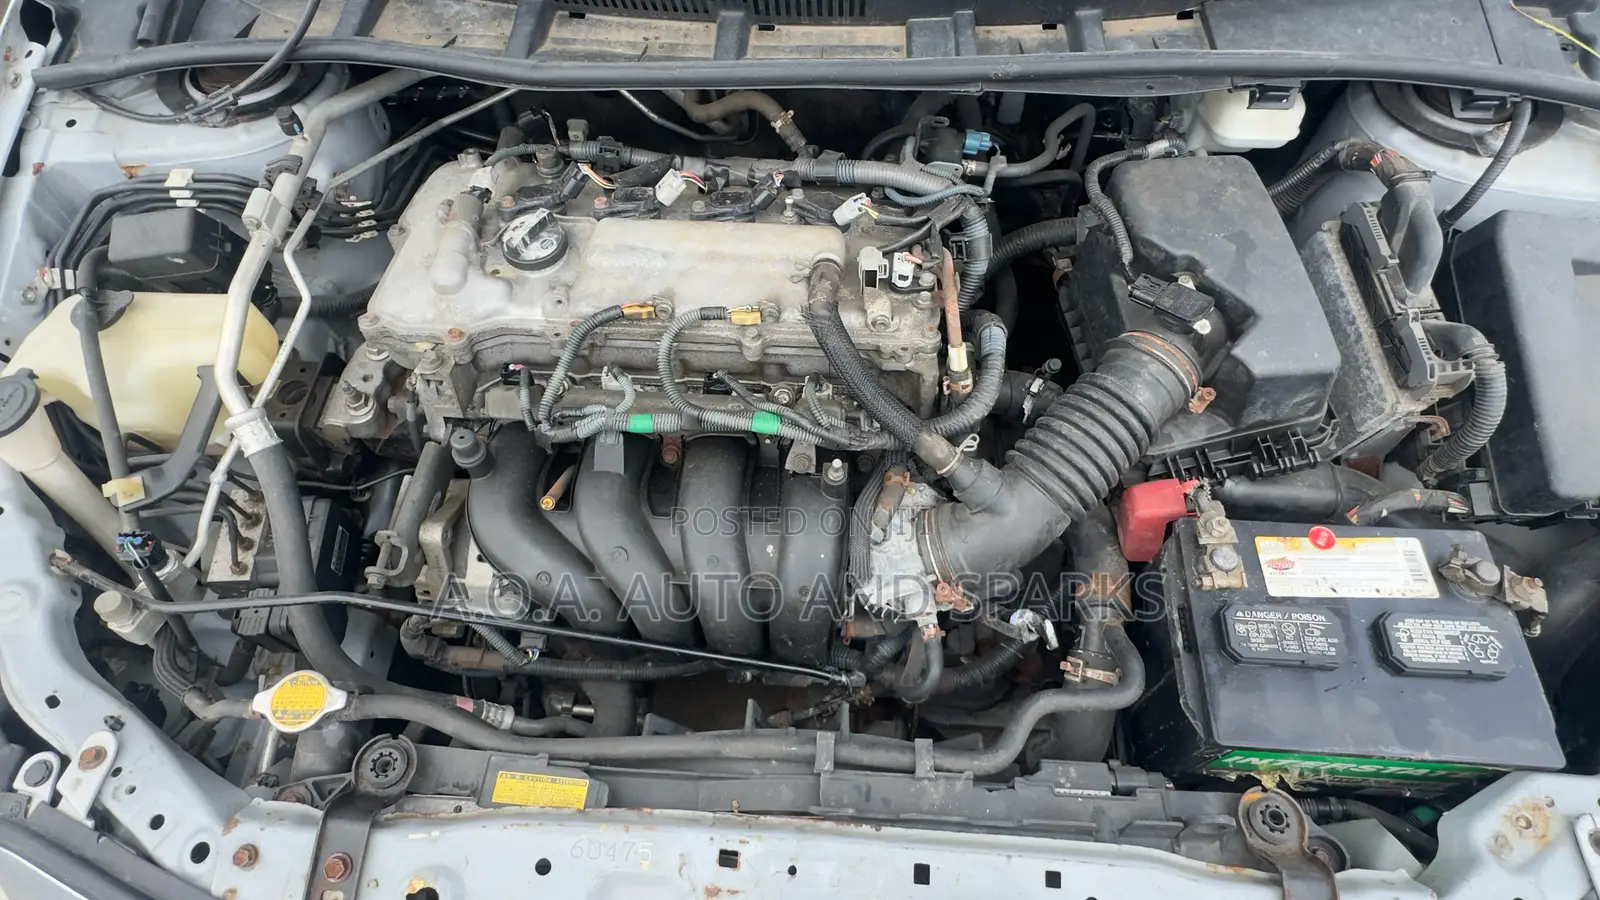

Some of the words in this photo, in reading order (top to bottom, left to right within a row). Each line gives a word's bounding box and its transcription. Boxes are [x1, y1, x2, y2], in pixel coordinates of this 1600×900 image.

[1244, 610, 1282, 619] DANGER
[1291, 612, 1327, 622] POISON
[569, 838, 654, 864] 60475
